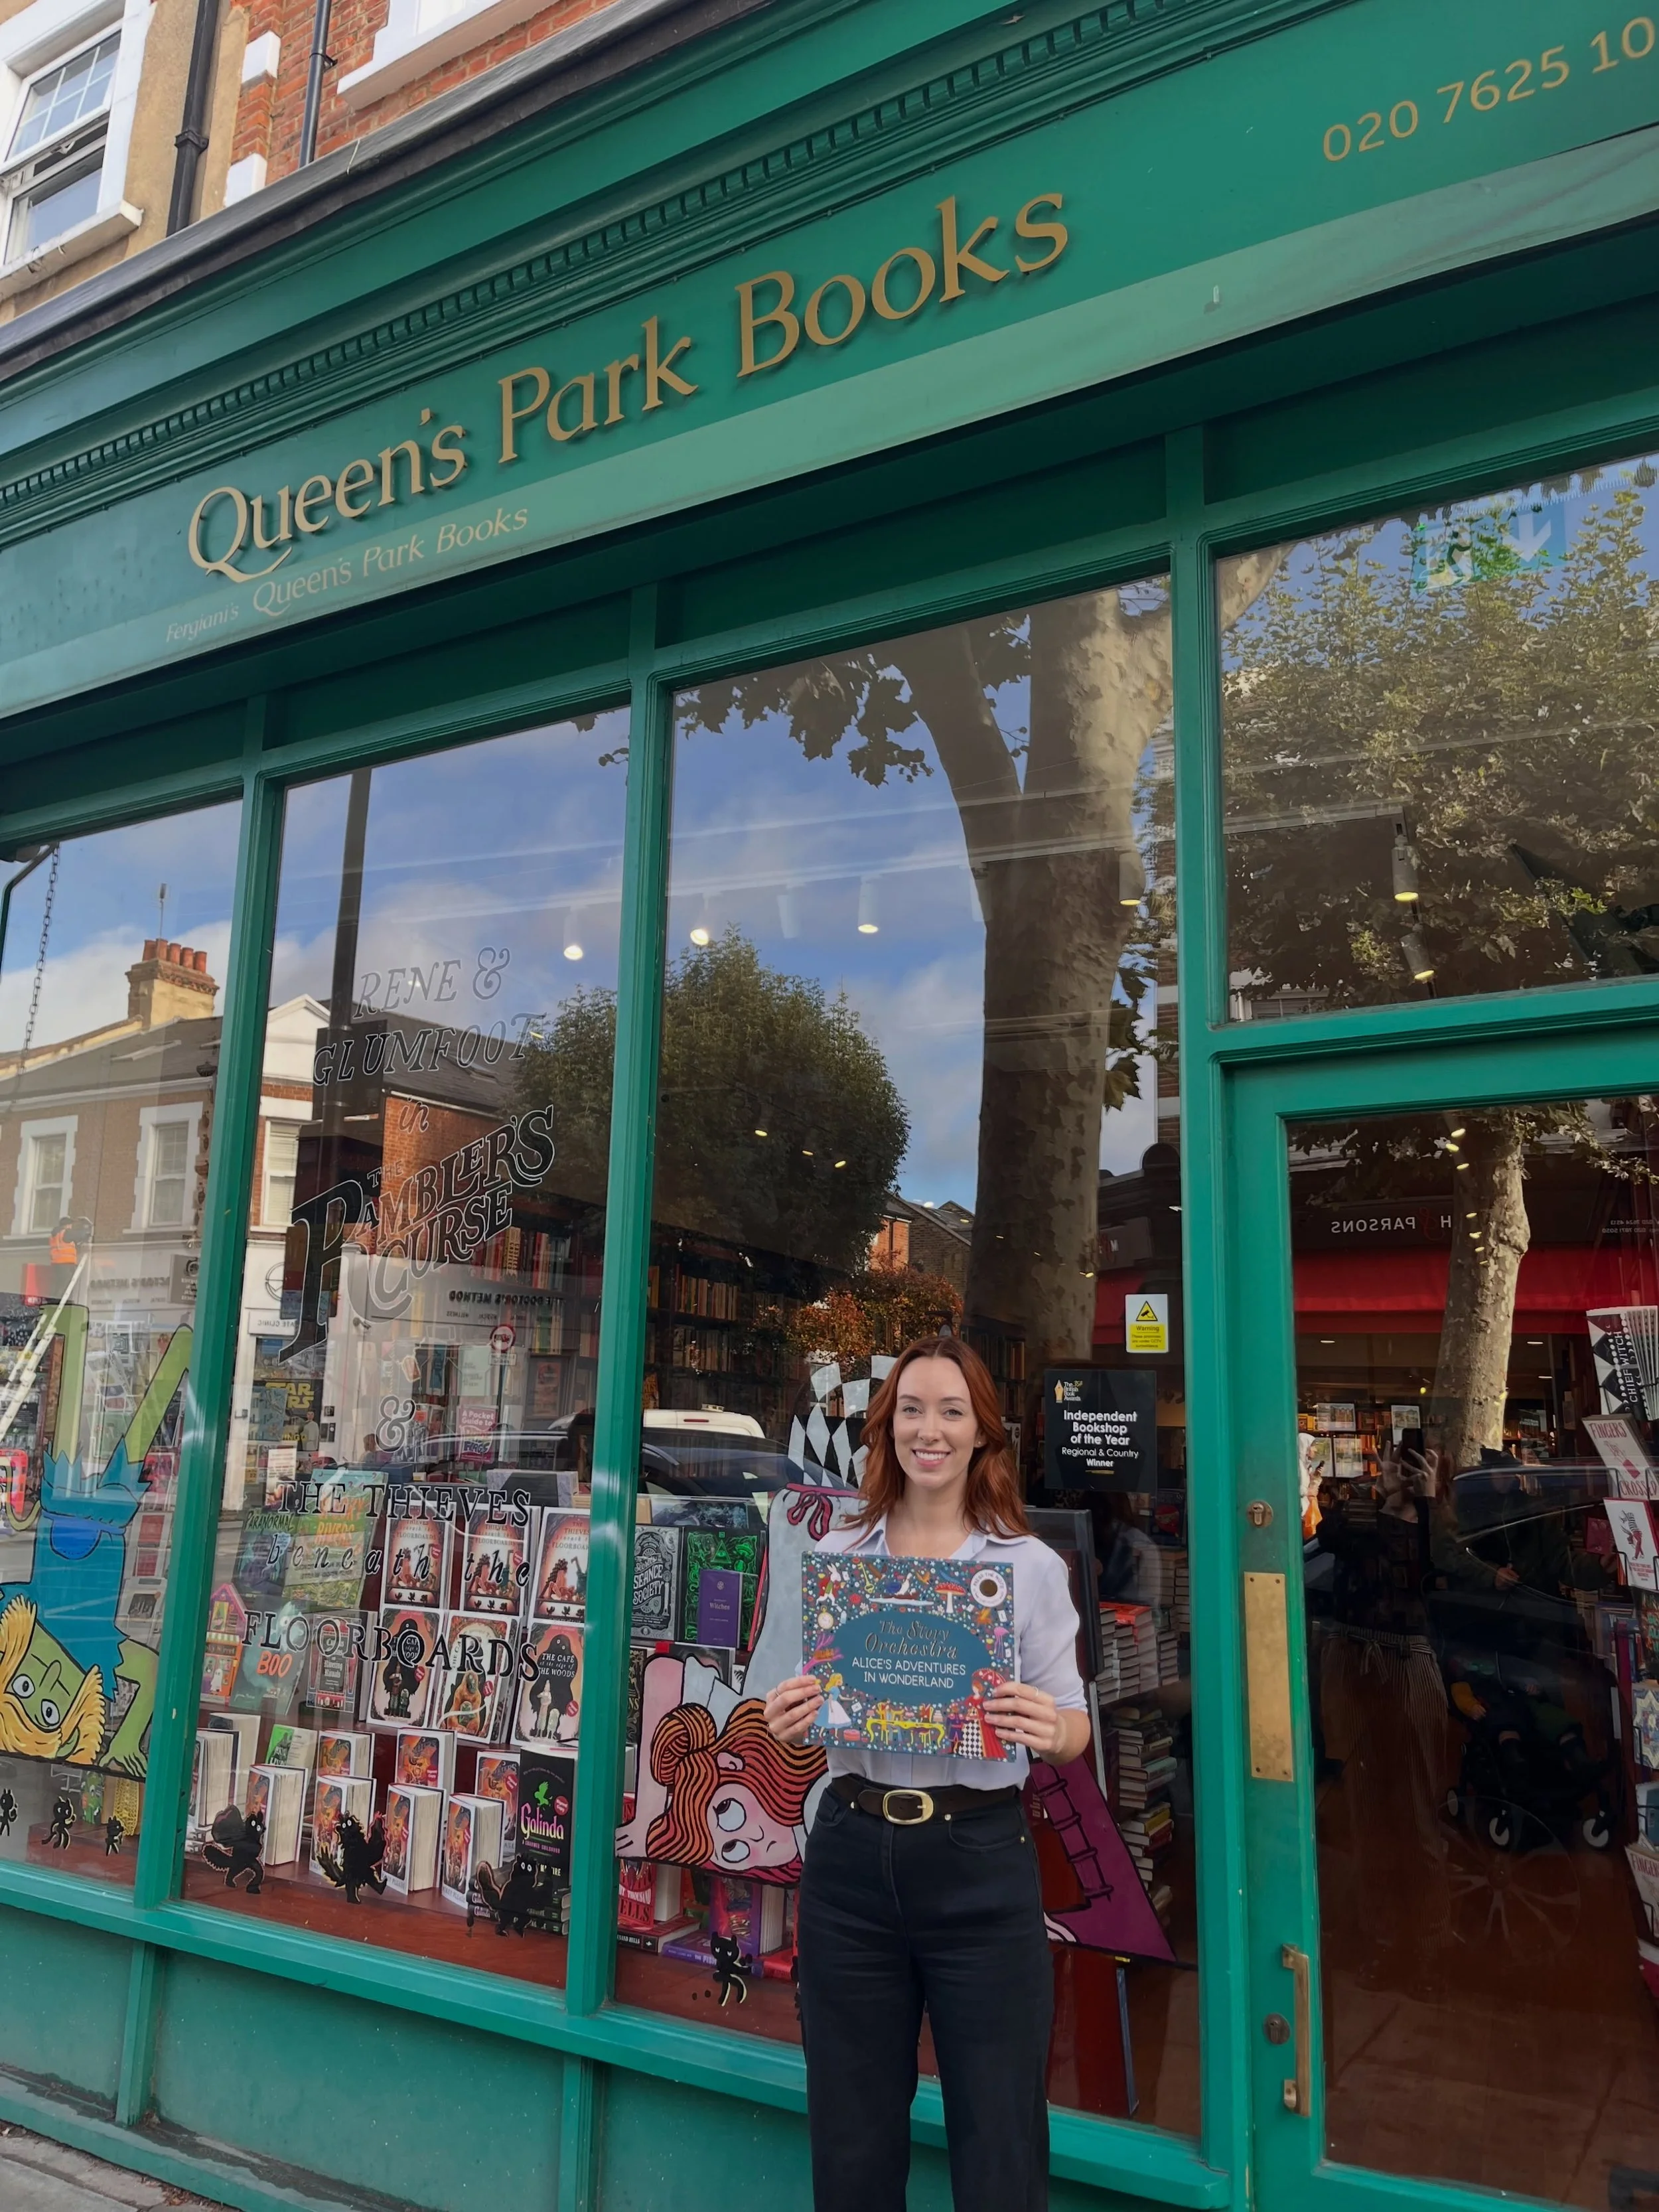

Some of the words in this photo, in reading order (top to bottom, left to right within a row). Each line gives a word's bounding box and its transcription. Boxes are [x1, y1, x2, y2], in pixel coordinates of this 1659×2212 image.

[1323, 100, 1419, 161] 020
[1437, 45, 1570, 124] 7625
[188, 407, 469, 583] Queen's
[497, 315, 699, 463] Park
[735, 193, 1069, 378] Books
[253, 557, 352, 617] Queen's
[363, 534, 425, 577] Park
[436, 507, 528, 554] Books
[354, 959, 461, 1020] RENE
[472, 946, 510, 1000] &
[313, 1012, 547, 1086] GLUMFOOT
[398, 1097, 429, 1134] in
[366, 1160, 403, 1188] THE
[279, 1104, 555, 1364] RAMBLER'S
[374, 1181, 513, 1303] CURSE
[1615, 1331, 1629, 1366] WITCH
[1626, 1368, 1638, 1403] CHIEF
[375, 1395, 416, 1453] &
[461, 1417, 483, 1426] Guide
[469, 1411, 494, 1420] Pocket
[1064, 1410, 1137, 1422] Independent
[1072, 1422, 1127, 1435] Bookshop
[1070, 1434, 1082, 1444] of
[1084, 1434, 1101, 1445] the
[1104, 1434, 1130, 1445] Year
[1589, 1422, 1627, 1439] FINGERS
[1062, 1447, 1097, 1457] Regional
[1106, 1449, 1139, 1459] Country
[1086, 1458, 1114, 1467] Winner
[276, 1481, 346, 1515] THE
[363, 1484, 530, 1527] THIEVES
[244, 1511, 296, 1532] PARANORMAL
[267, 1533, 430, 1581] beneath
[464, 1550, 530, 1587] the
[634, 1564, 664, 1589] SEANCE
[632, 1580, 664, 1605] SOCIETY
[879, 1619, 902, 1634] The
[907, 1619, 950, 1642] Story
[241, 1610, 541, 1682] FLOORBOARDS
[865, 1632, 959, 1659] Orchestra
[256, 1651, 293, 1678] BOO
[551, 1669, 575, 1678] WOODS
[852, 1657, 892, 1670] ALICE'S
[895, 1660, 966, 1676] ADVENTURES
[864, 1671, 876, 1682] IN
[879, 1672, 954, 1689] WONDERLAND
[520, 1803, 565, 1840] Galinda
[620, 1898, 650, 1923] ELLS
